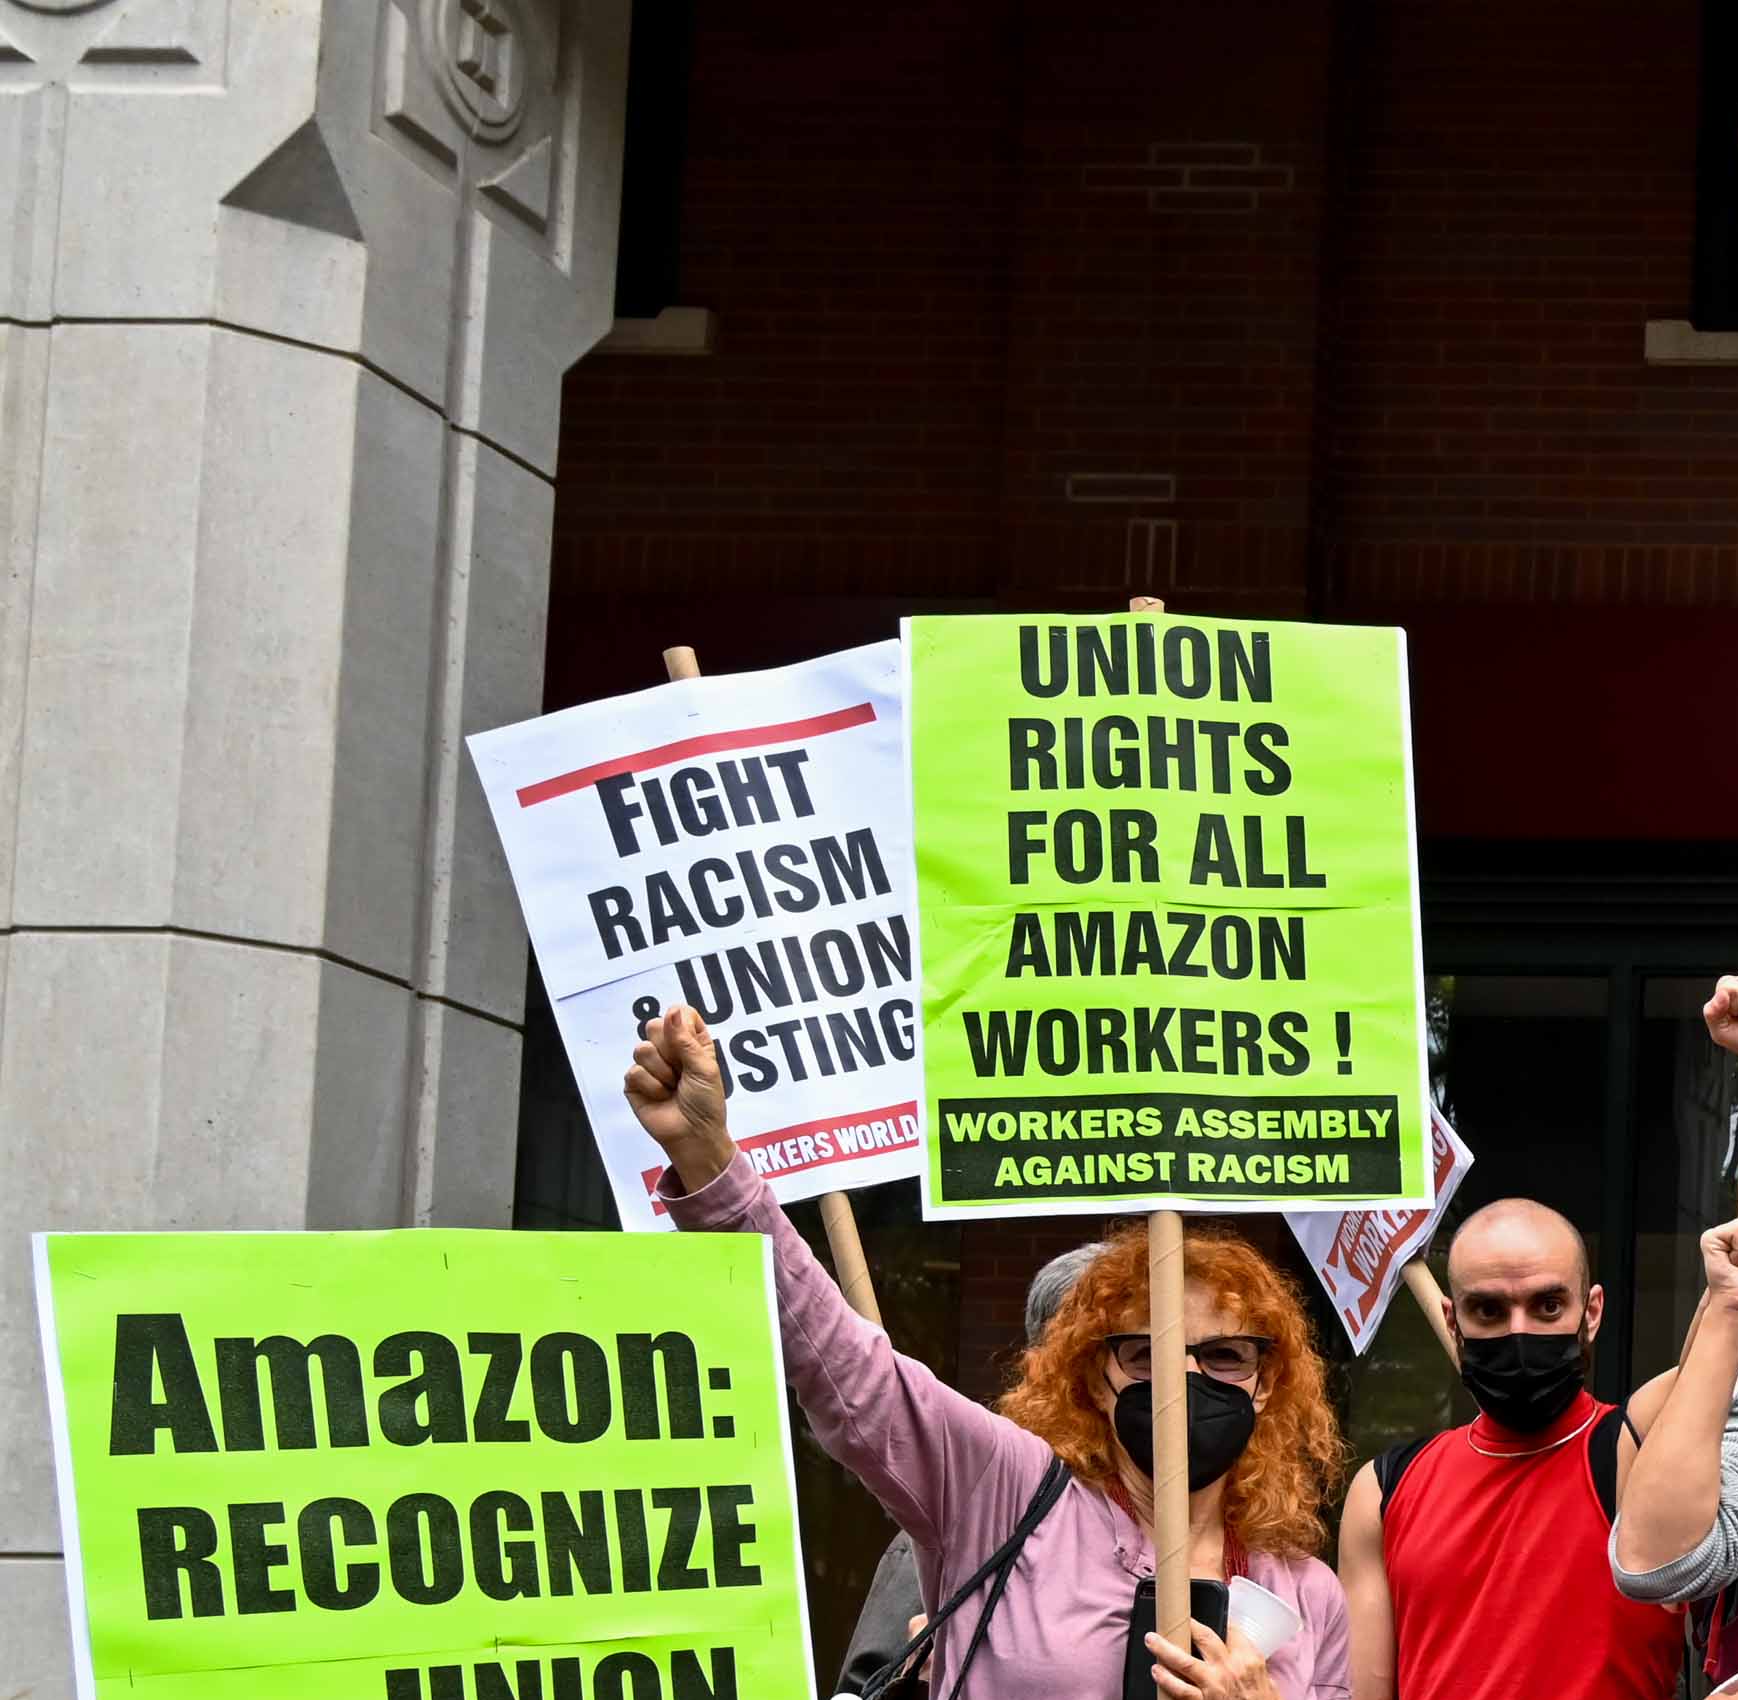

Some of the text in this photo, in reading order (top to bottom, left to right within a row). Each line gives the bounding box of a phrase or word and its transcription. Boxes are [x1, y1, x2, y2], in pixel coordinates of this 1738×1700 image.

[1018, 622, 1273, 703] UNION
[1008, 715, 1292, 796] RIGHTS
[1007, 808, 1327, 889] FOR ALL
[587, 827, 891, 960] RACISM
[674, 914, 912, 1026] UNION
[1005, 910, 1307, 981] AMAZON
[963, 1007, 1310, 1078] WORKERS
[833, 1114, 919, 1155] WORLD
[945, 1106, 1393, 1143] WORKERS ASSEMBLY
[994, 1151, 1350, 1187] AGAINST RACISM
[109, 1313, 736, 1456] Amazon:
[137, 1484, 763, 1621] RECOGNIZE
